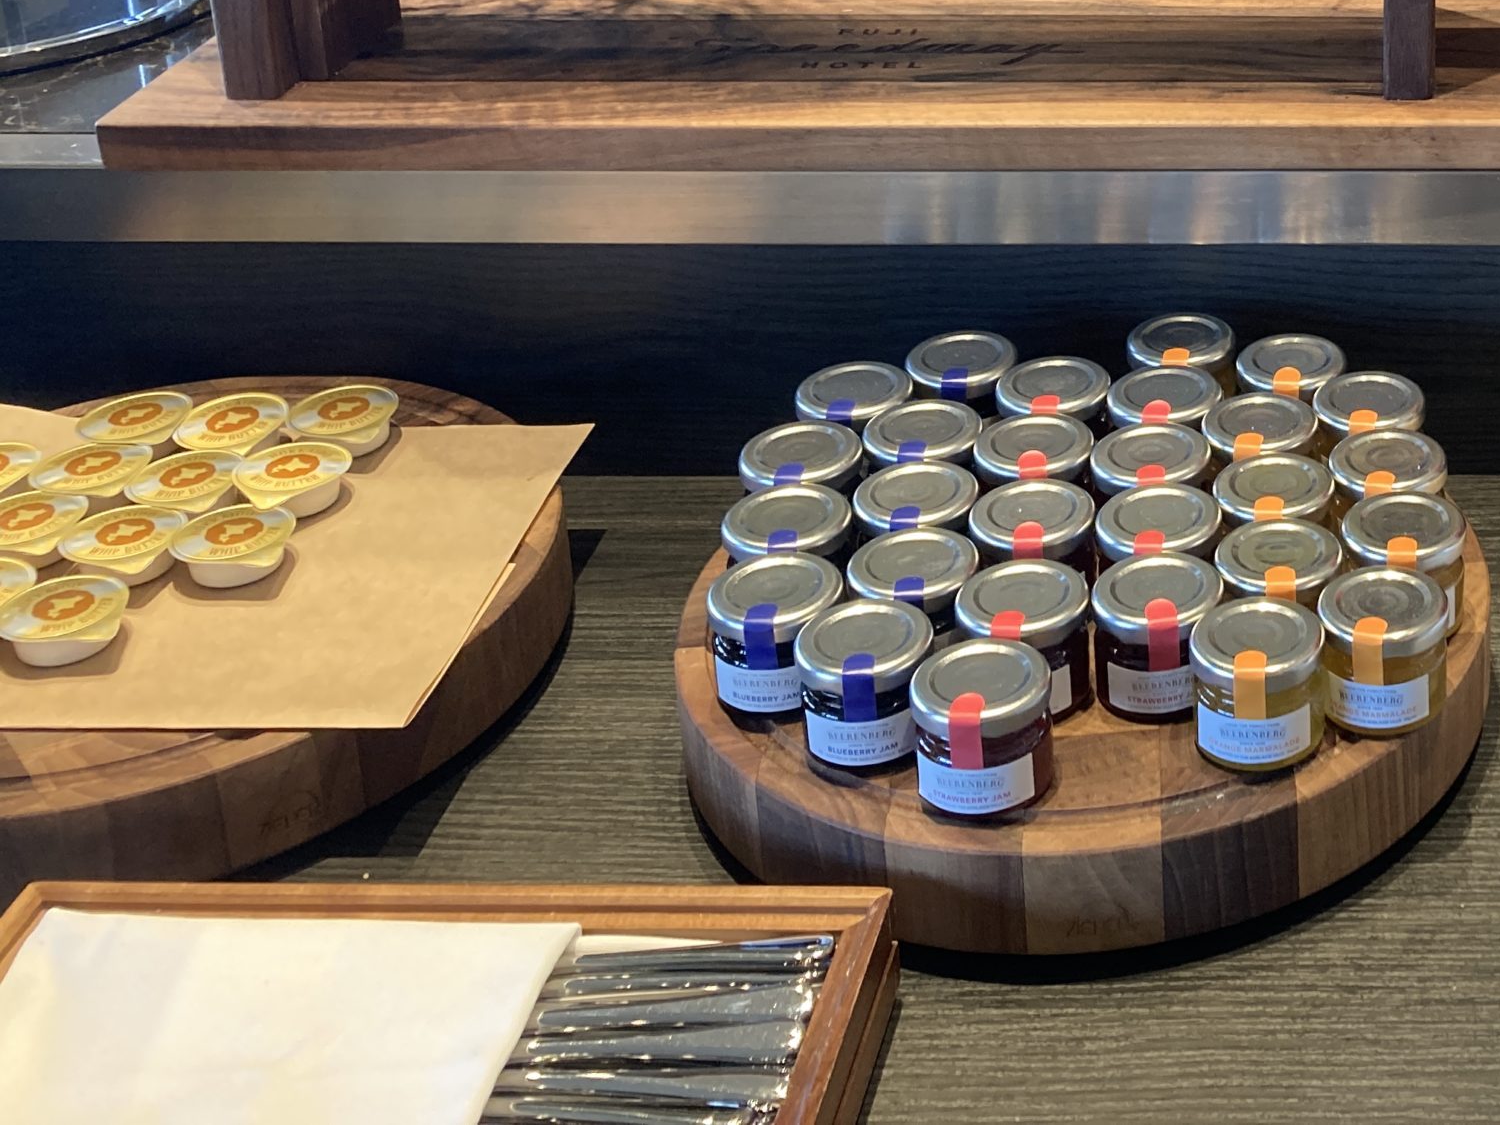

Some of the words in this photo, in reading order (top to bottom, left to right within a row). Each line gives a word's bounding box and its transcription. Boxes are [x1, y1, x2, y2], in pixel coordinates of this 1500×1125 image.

[800, 60, 924, 70] HOTEL
[732, 691, 778, 703] BLUEBERRY
[1127, 694, 1183, 705] STRAWBERRY
[827, 729, 896, 741] BEERENBERG
[1219, 728, 1287, 739] BEERENBERG
[827, 745, 877, 756] BLUEBERRY
[879, 742, 899, 753] JAM
[932, 789, 989, 804] STRAWBERRY
[992, 790, 1012, 802] JAM
